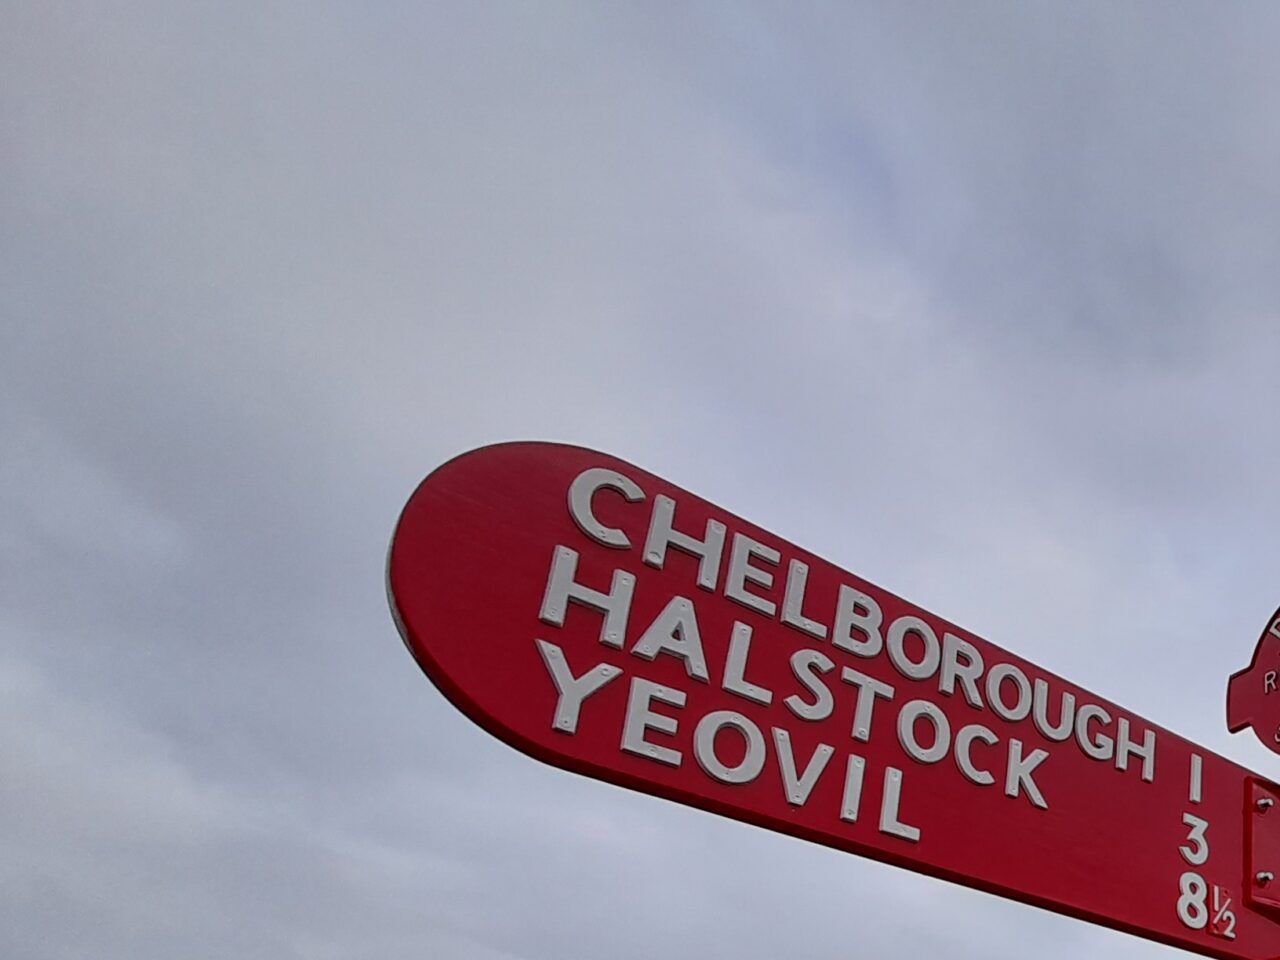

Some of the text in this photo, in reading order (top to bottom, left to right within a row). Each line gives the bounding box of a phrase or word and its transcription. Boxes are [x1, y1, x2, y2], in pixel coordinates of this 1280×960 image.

[535, 638, 922, 842] YEOVIL
[537, 544, 1209, 866] HALSTOCK 3
[567, 467, 1157, 782] CHELBOROUGH
